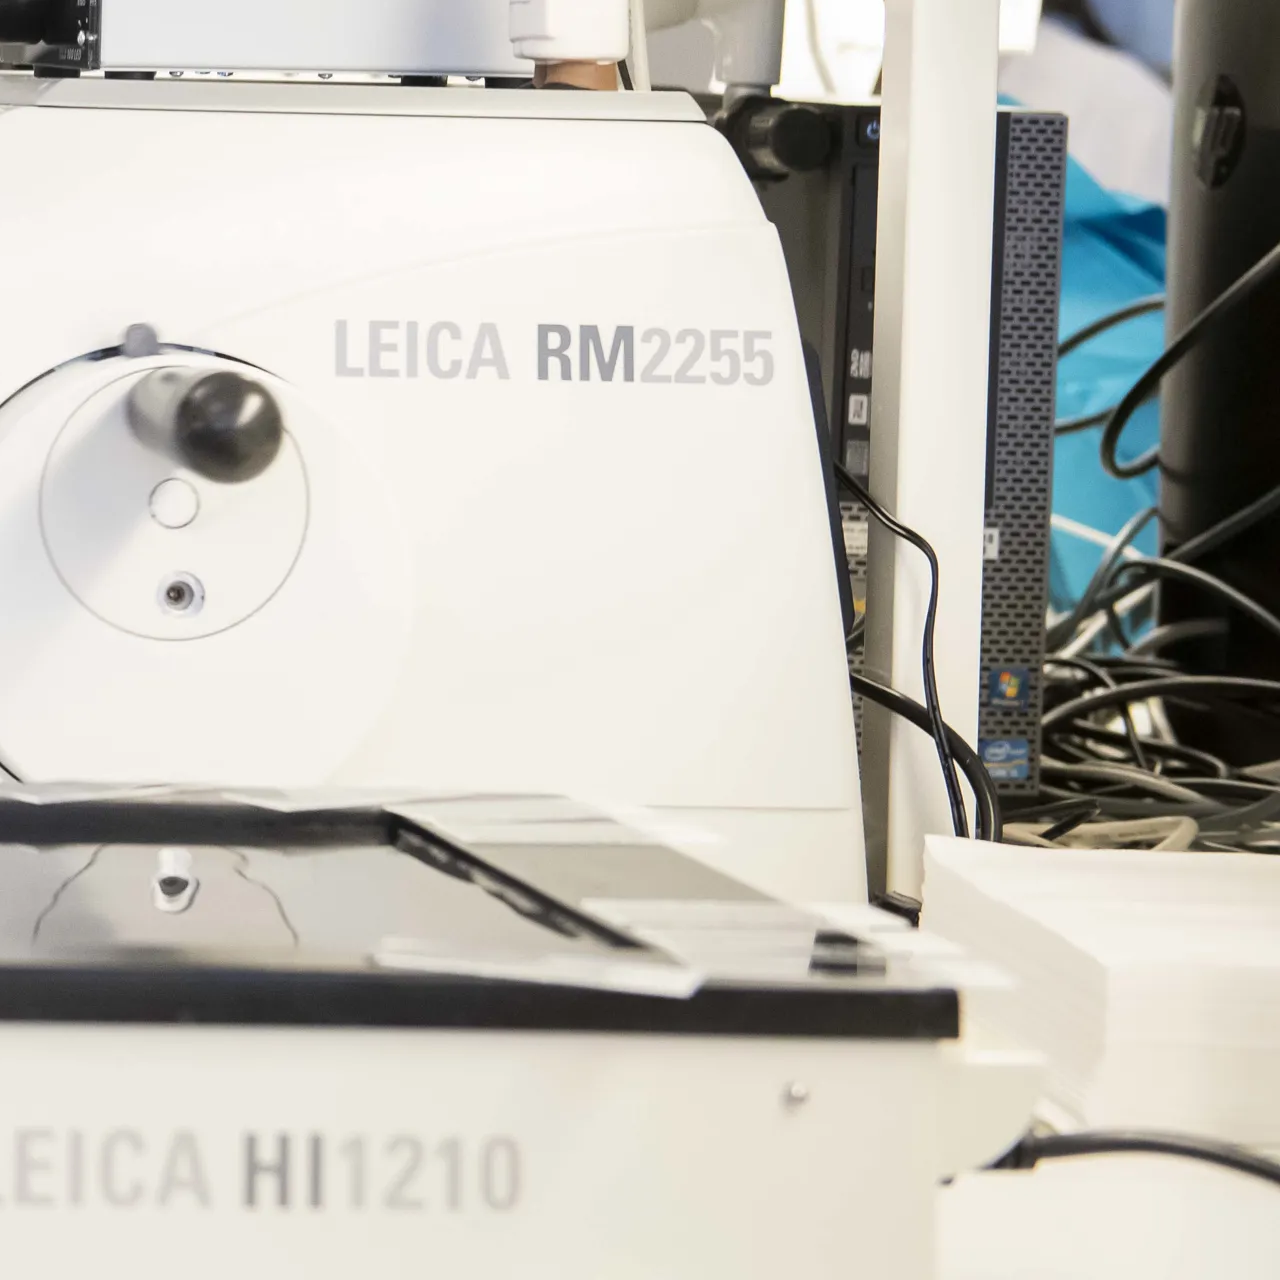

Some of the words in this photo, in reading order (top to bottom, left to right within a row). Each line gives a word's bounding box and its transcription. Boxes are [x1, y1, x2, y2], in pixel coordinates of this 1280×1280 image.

[334, 319, 511, 380] LEICA
[537, 323, 775, 387] RM2255
[239, 1131, 524, 1214] HI1210
